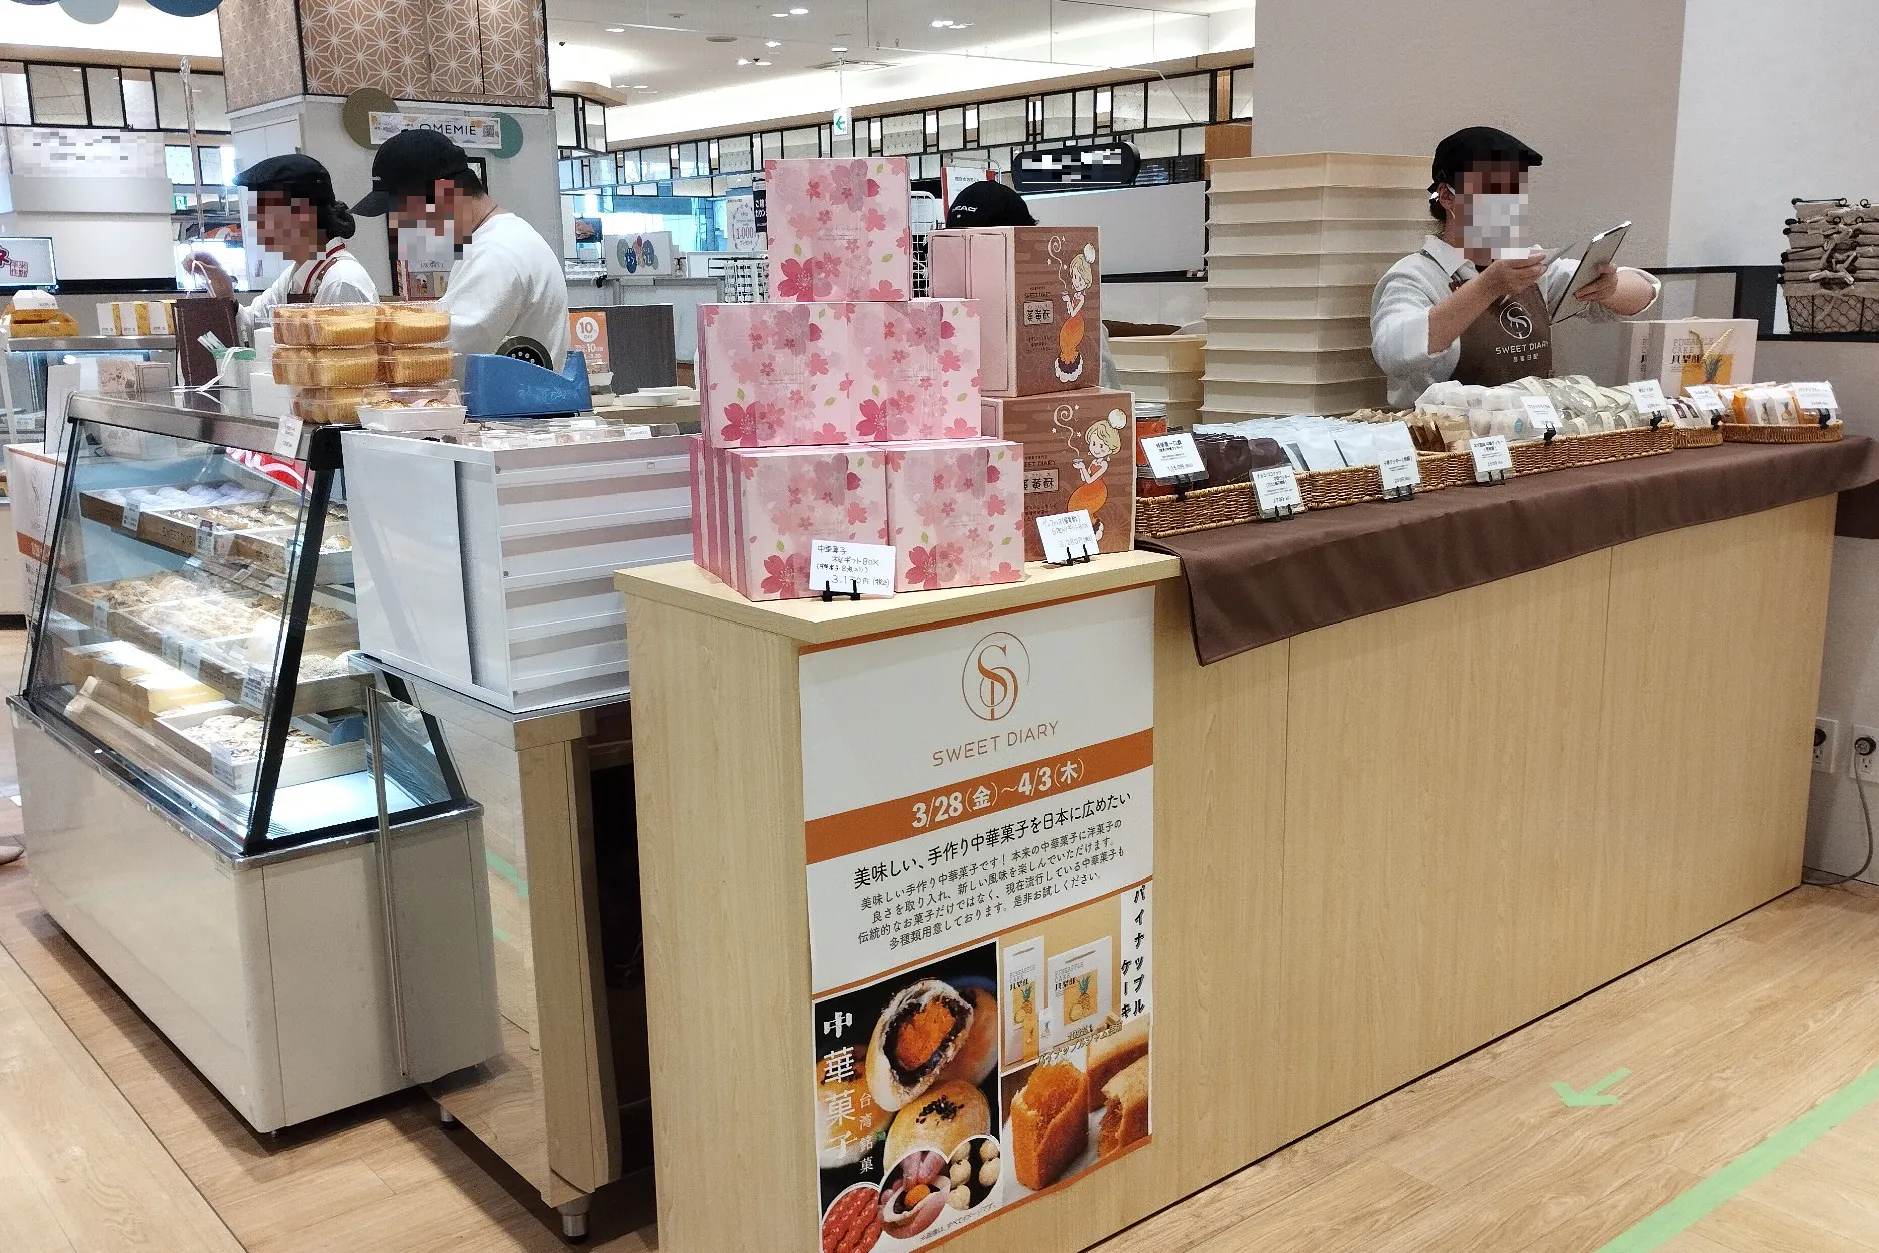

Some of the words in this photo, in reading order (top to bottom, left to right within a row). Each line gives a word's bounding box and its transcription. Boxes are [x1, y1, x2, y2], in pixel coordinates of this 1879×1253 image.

[1495, 345, 1527, 355] SWEET
[1673, 338, 1714, 347] PINEAPLE
[933, 735, 1001, 766] SWEET
[1007, 720, 1059, 747] DIARY
[854, 793, 1131, 890] 美味しい、手作り中華菓子を日本に広めたい
[872, 837, 1114, 924] 良さを取り入れ、新しい風味を楽しんでいただけます。
[857, 846, 1125, 944] 伝統的なお菓子だけではなく、現在流行している中華菓子も
[1120, 959, 1132, 1019] ケーキ
[1133, 884, 1146, 1017] パイナップル
[823, 1011, 858, 1160] 中華菓子
